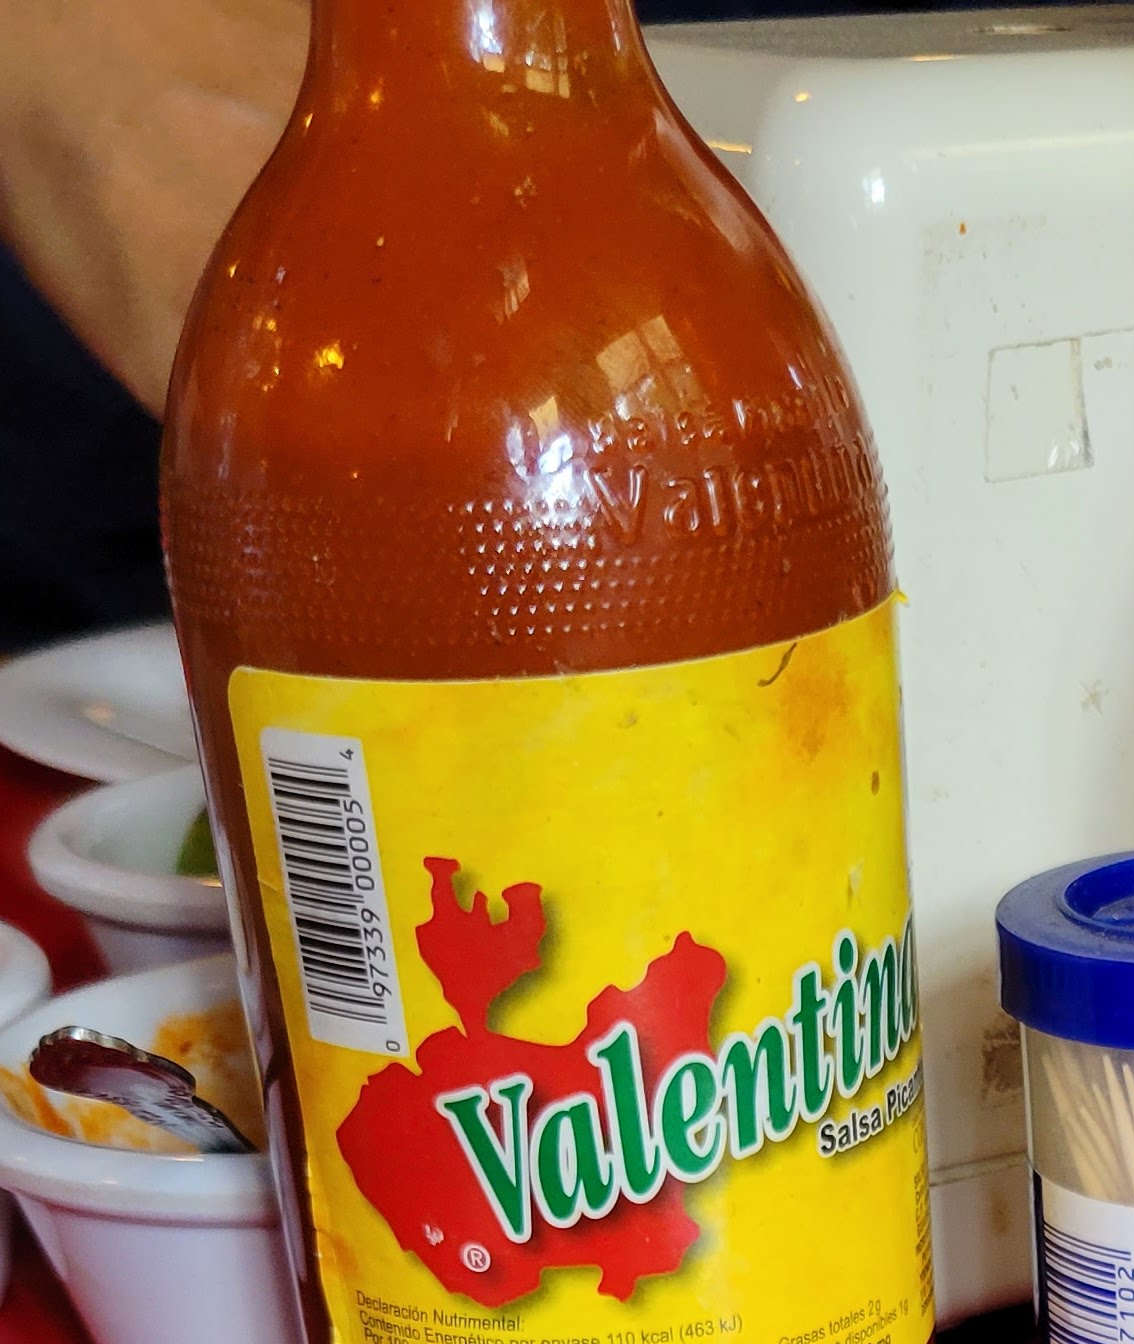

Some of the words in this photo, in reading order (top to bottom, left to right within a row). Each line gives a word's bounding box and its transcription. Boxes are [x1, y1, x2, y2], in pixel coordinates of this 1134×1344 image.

[819, 1106, 883, 1154] Salsa
[356, 1290, 429, 1322] Declaración
[433, 1308, 525, 1332] Nutrimental:
[359, 1309, 421, 1341] Contenido
[641, 1327, 674, 1344] kcal
[679, 1319, 715, 1344] (463
[719, 1313, 744, 1333] kJ)
[829, 1307, 866, 1334] totales
